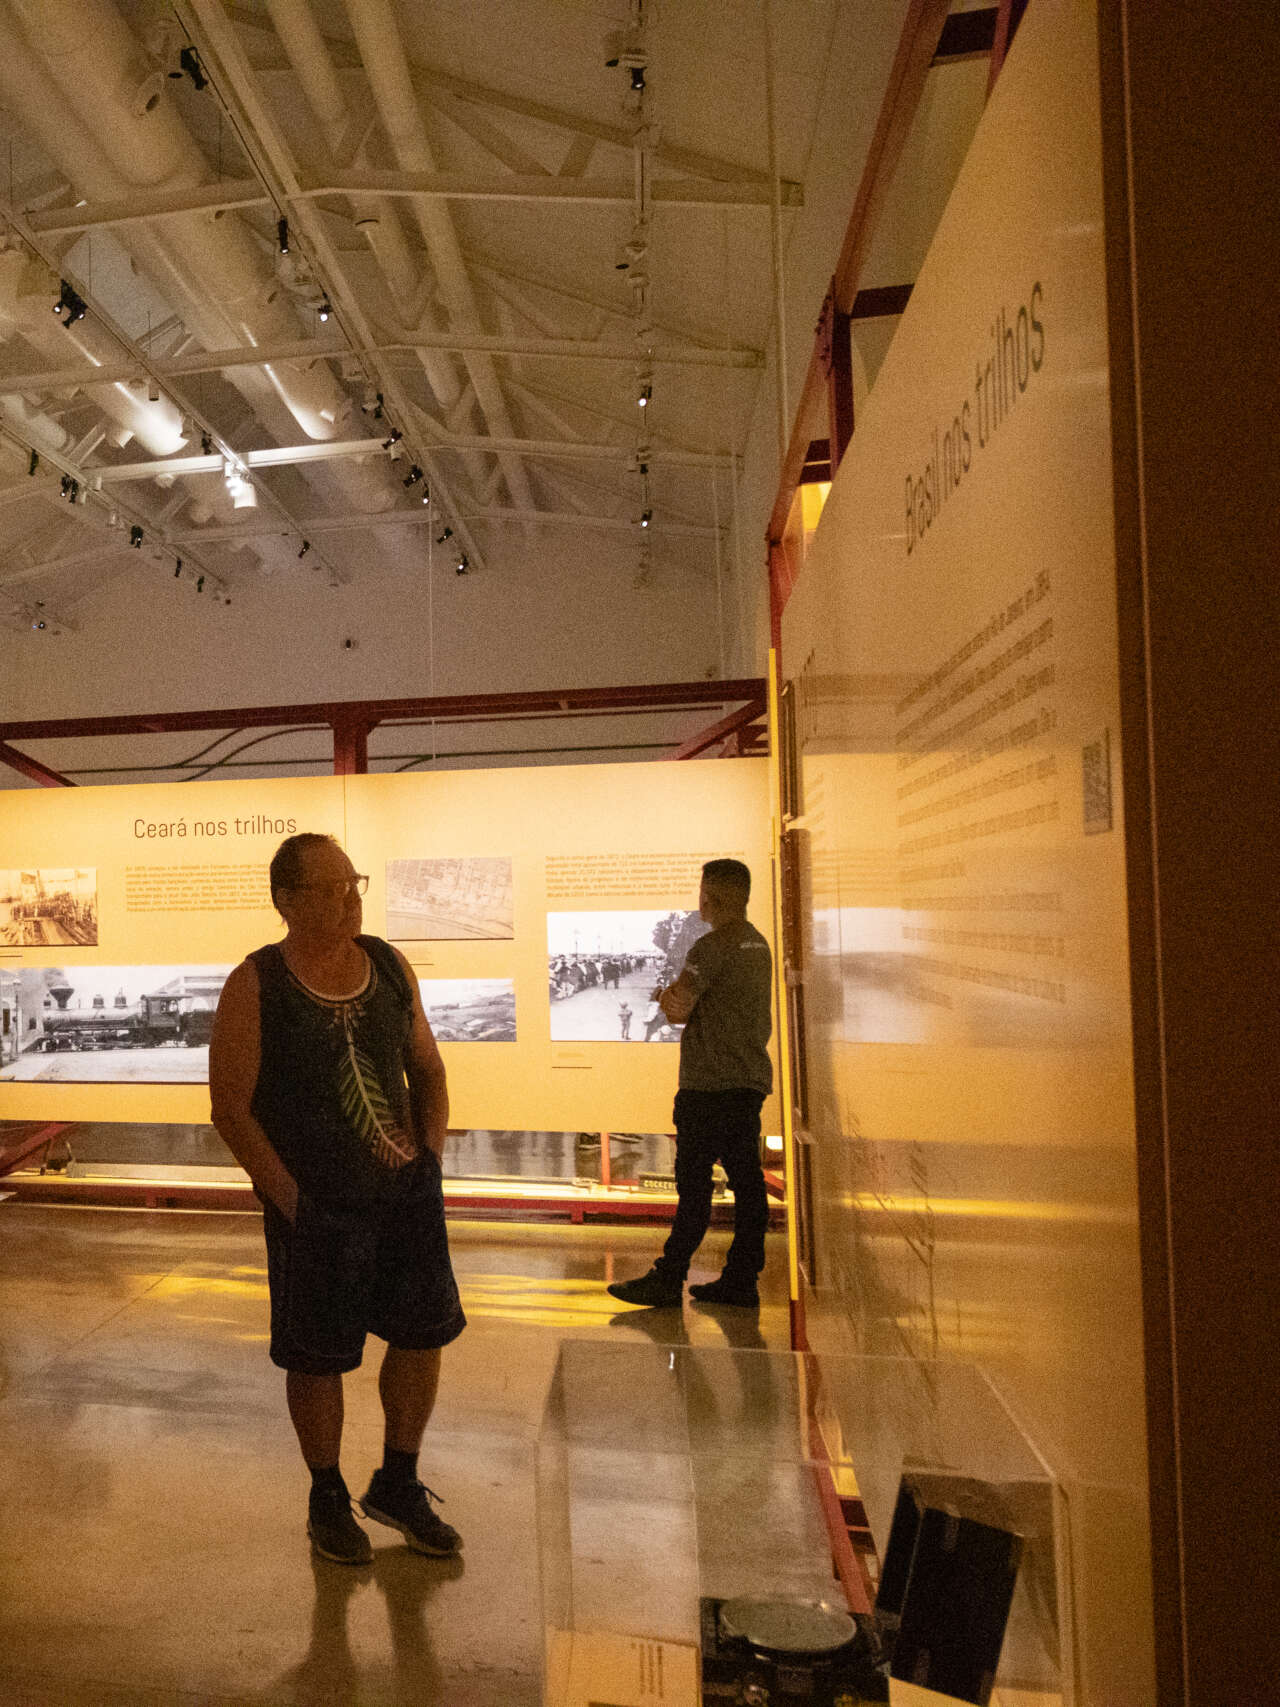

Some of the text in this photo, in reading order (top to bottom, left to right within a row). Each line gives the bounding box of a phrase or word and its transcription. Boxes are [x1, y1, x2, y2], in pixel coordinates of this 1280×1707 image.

[906, 281, 1045, 556] Brasil nos trilhos
[134, 815, 297, 838] Ceará nos trilhos
